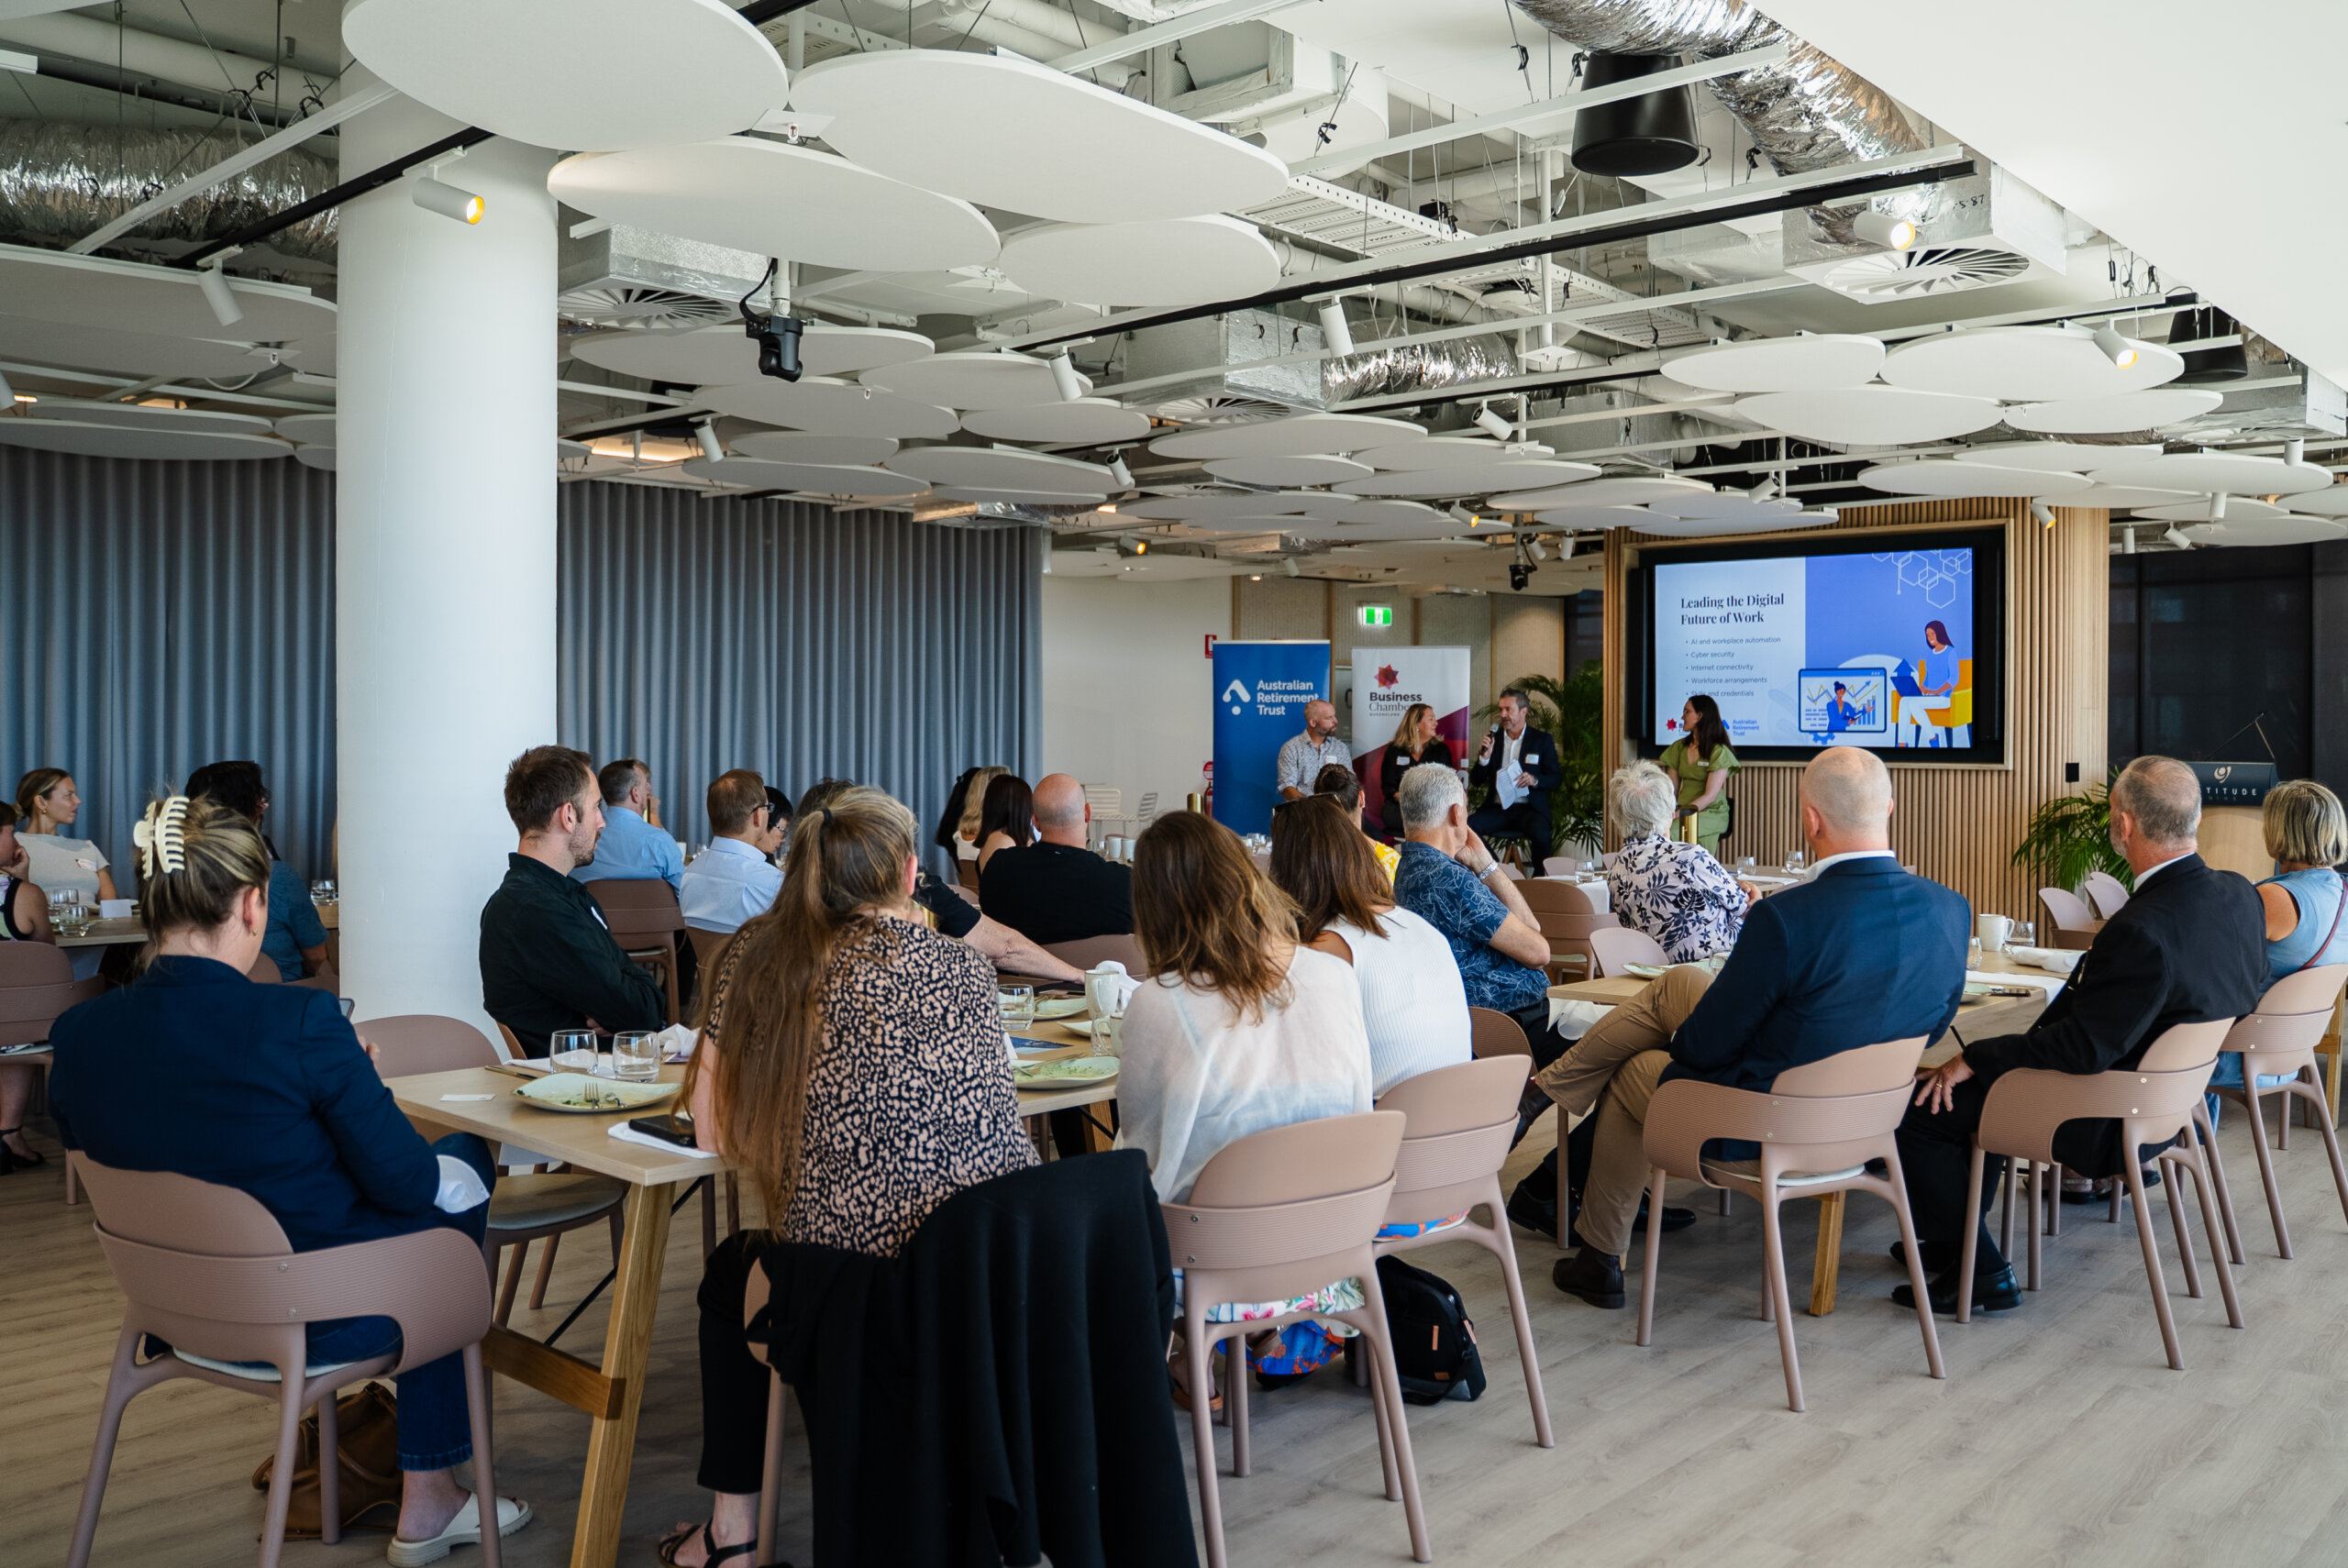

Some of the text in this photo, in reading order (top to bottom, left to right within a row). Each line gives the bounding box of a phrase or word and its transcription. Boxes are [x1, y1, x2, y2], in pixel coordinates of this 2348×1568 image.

[1680, 593, 1784, 610] Leading the Digital
[1680, 611, 1765, 625] Future of Work
[1711, 637, 1744, 646] workplace
[1744, 636, 1781, 645] automation
[1690, 651, 1710, 659] Cyber
[1716, 663, 1755, 671] connectivity
[1257, 679, 1313, 690] Australian
[1257, 691, 1320, 703] Retirement
[1369, 691, 1423, 701] Business
[1257, 704, 1286, 715] Trust
[1369, 702, 1410, 712] Chambe
[2206, 787, 2256, 795] TITUDE
